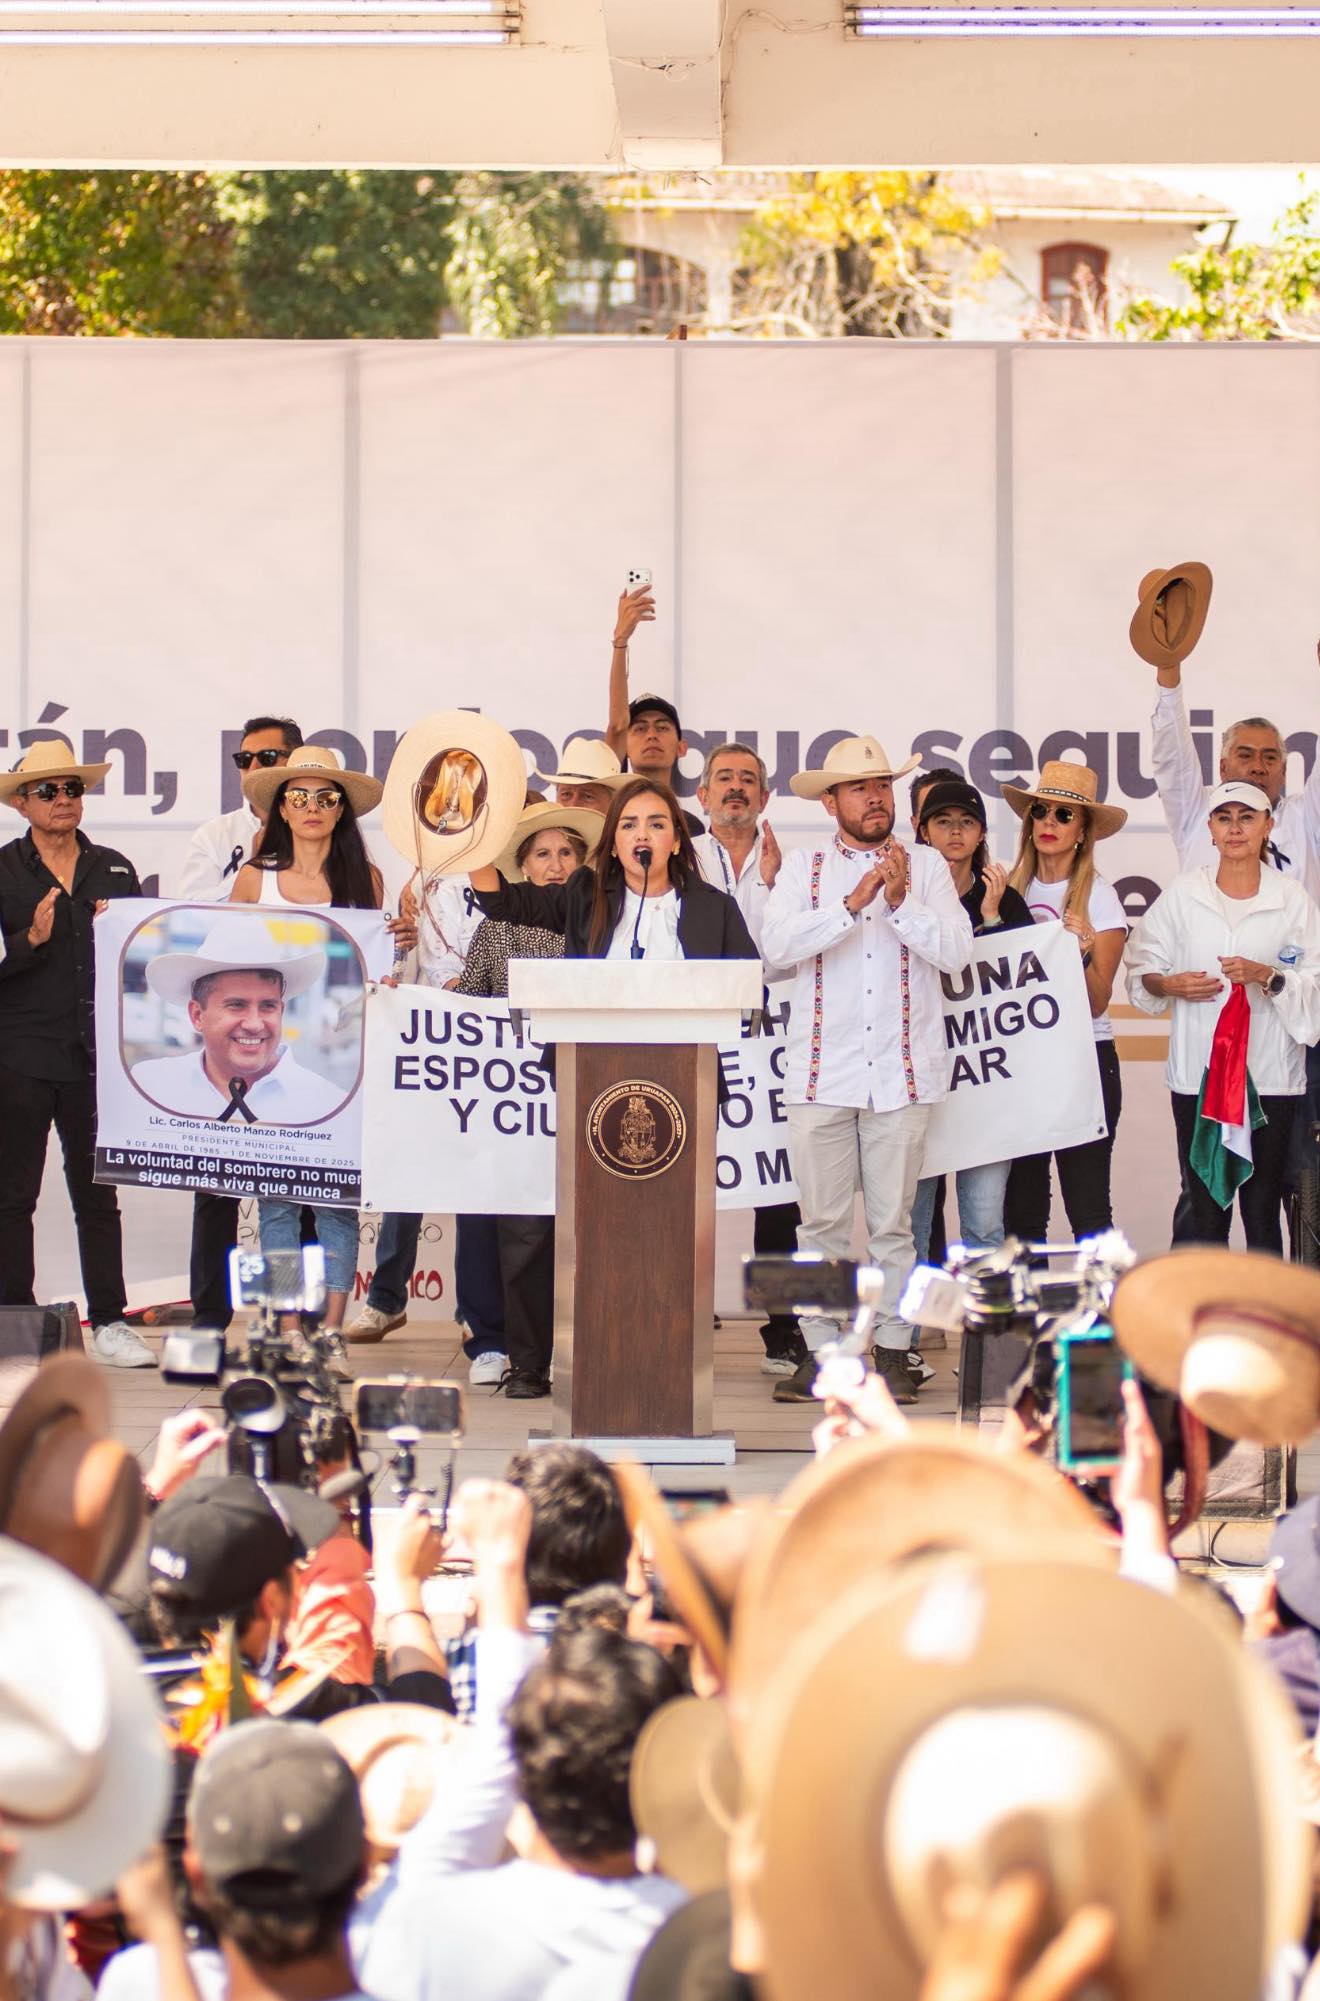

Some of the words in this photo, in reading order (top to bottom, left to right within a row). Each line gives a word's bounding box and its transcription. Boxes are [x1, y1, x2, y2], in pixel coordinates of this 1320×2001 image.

[0, 701, 178, 815] án,
[939, 950, 1049, 1002] UNA
[400, 1008, 546, 1050] JUST
[394, 1055, 556, 1095] ESPOS
[641, 1085, 672, 1105] URUAPAN
[149, 1116, 167, 1126] Lic.
[169, 1118, 201, 1130] Carlos
[203, 1121, 241, 1134] Alberto
[243, 1126, 276, 1137] Manzo
[280, 1129, 332, 1141] Rodríguez
[449, 1098, 479, 1133] Y
[151, 1142, 178, 1151] ABRIL
[183, 1145, 196, 1153] DE
[200, 1147, 220, 1155] 1985
[254, 1152, 310, 1164] NOVIEMBRE
[331, 1159, 355, 1167] 2025
[182, 1134, 240, 1147] PRESIDENTE
[244, 1141, 297, 1152] MUNICIPAL
[106, 1149, 124, 1164] La
[128, 1152, 193, 1170] voluntad
[197, 1157, 220, 1173] del
[224, 1162, 296, 1180] sombrero
[301, 1169, 320, 1181] no
[138, 1169, 182, 1186] sigue
[186, 1173, 218, 1188] más
[223, 1177, 255, 1192] viva
[259, 1182, 288, 1197] que
[292, 1185, 340, 1199] nunca
[354, 1269, 444, 1301] MICO
